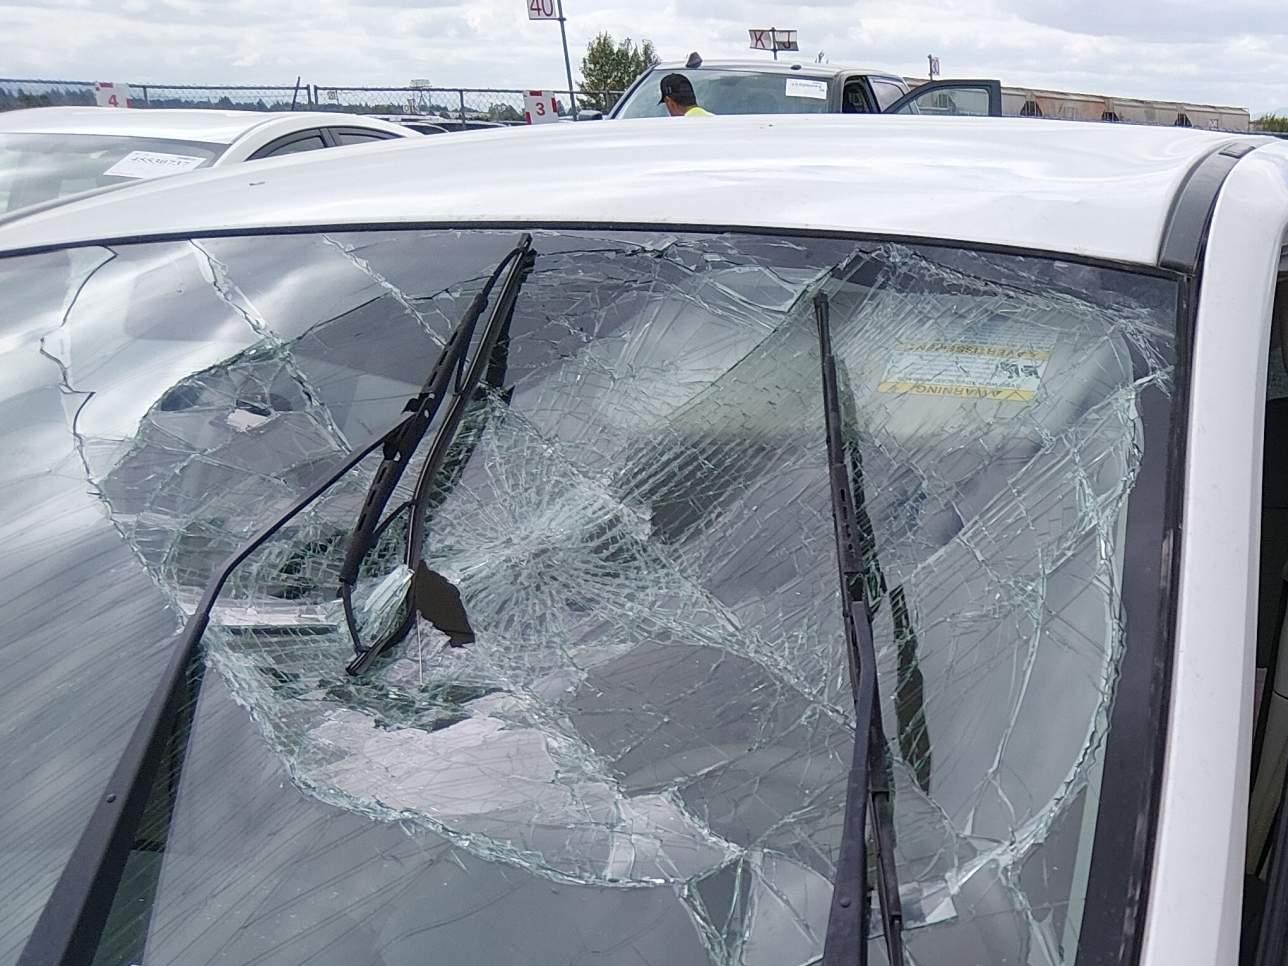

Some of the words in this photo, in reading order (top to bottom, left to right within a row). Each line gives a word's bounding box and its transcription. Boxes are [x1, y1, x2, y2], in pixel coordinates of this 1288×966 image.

[530, 0, 553, 16] 40
[753, 31, 766, 49] K
[783, 31, 791, 49] J
[108, 94, 119, 107] 4
[535, 102, 546, 116] 3
